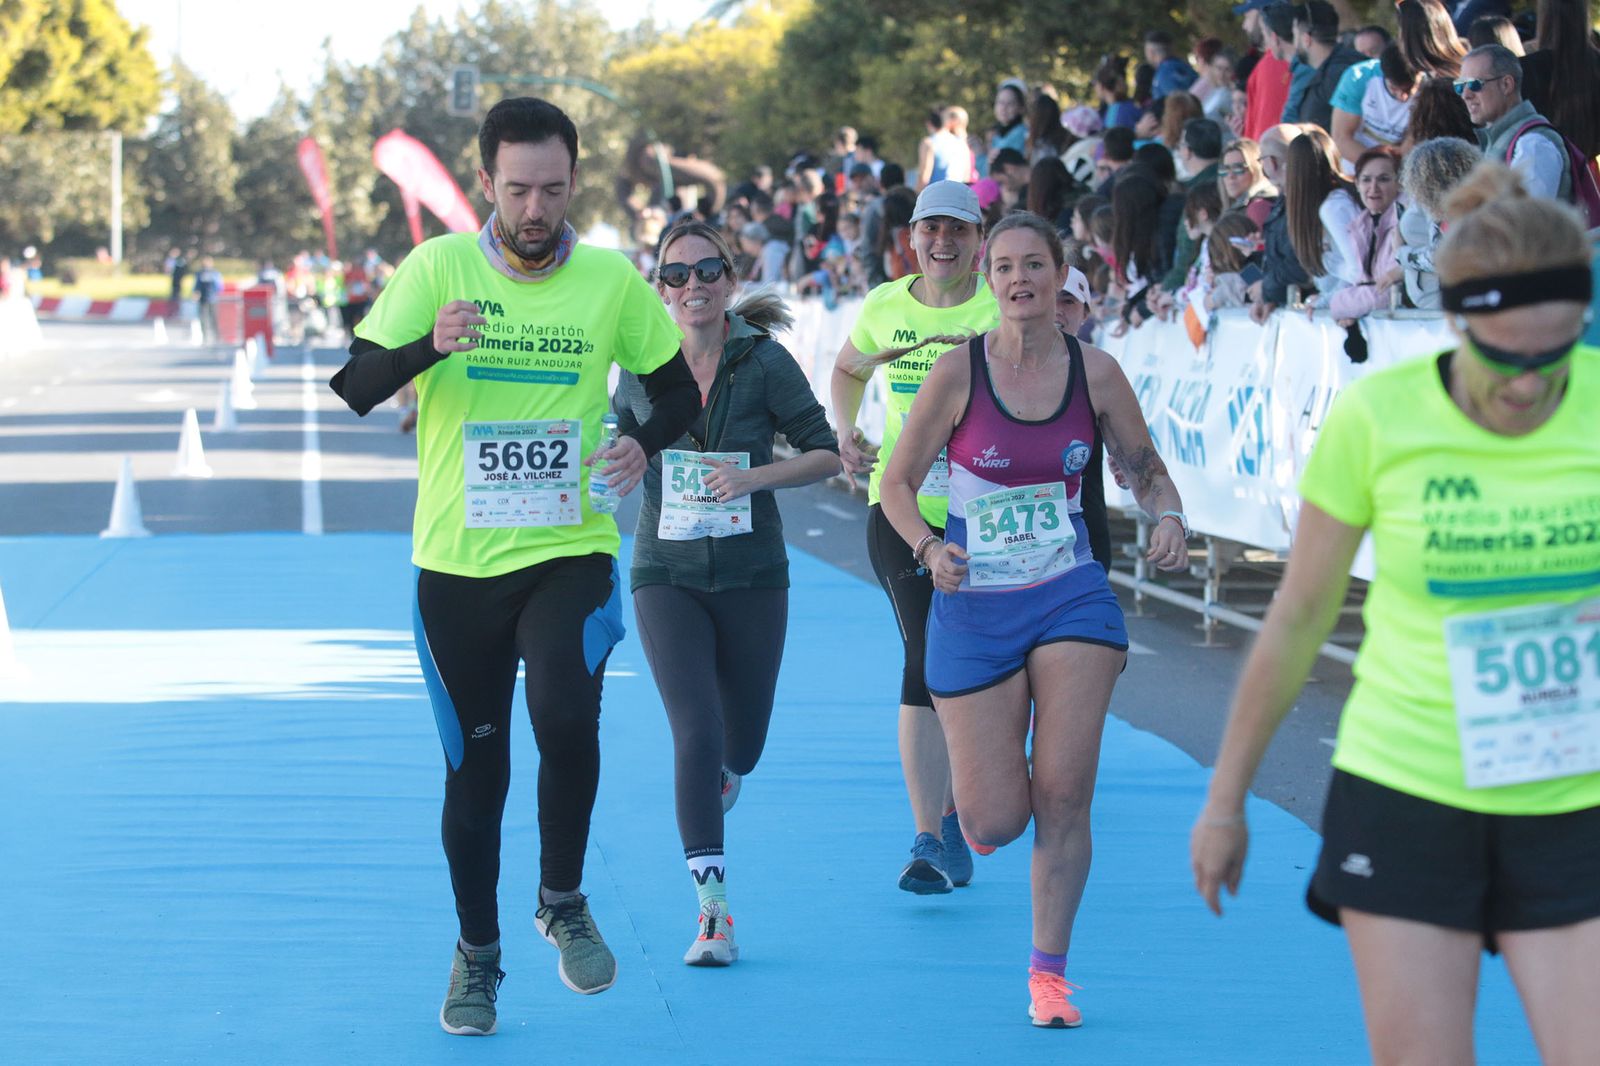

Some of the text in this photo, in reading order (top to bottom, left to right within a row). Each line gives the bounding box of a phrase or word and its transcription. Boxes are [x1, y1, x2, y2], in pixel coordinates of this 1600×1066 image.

[521, 324, 584, 337] Maratón
[466, 354, 583, 369] RAMÓN RUIZ ANDÚJAR
[478, 440, 569, 472] 5662
[972, 457, 1010, 468] TMRG
[484, 471, 562, 481] JOSÉ A. VILCHEZ
[671, 466, 715, 496] 547
[978, 501, 1060, 542] 5473
[1004, 532, 1036, 544] ISABEL
